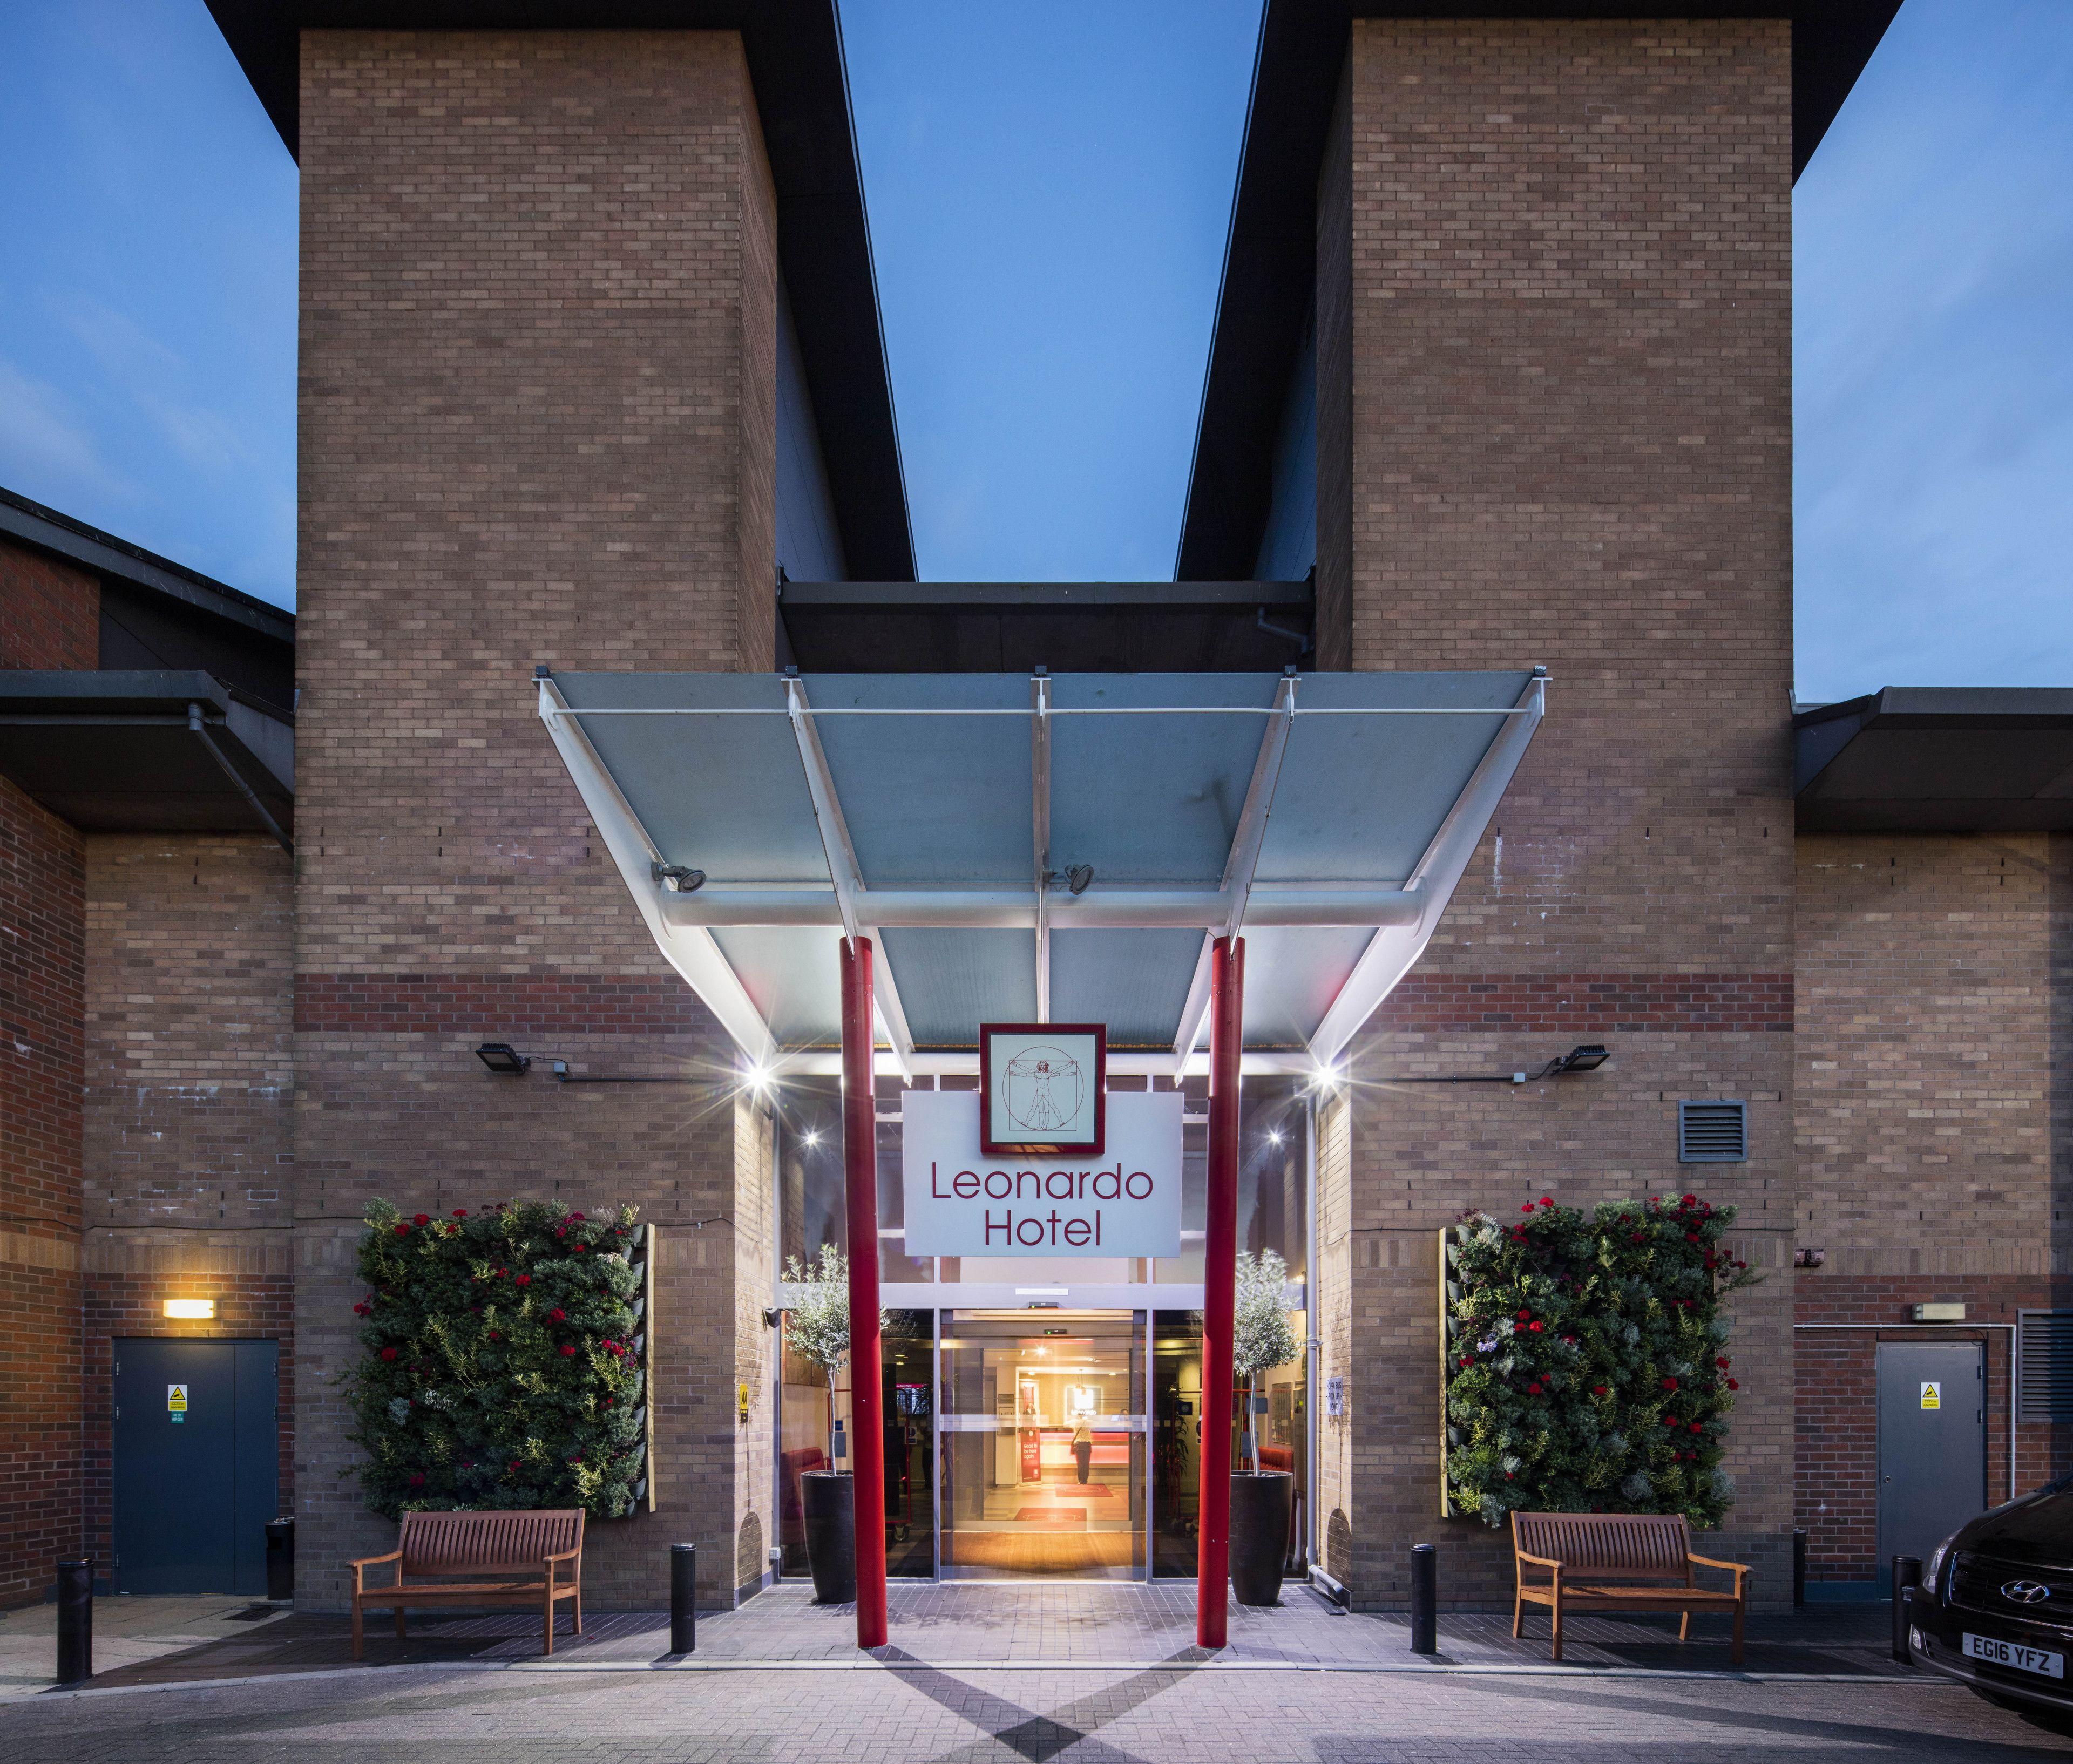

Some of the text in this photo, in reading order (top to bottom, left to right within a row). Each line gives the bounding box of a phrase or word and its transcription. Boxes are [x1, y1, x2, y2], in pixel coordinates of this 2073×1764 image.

[932, 1162, 1154, 1200] Leonardo
[985, 1209, 1101, 1246] Hotel
[741, 1391, 747, 1404] AA
[1973, 1637, 2050, 1672] EG16 YFZ
